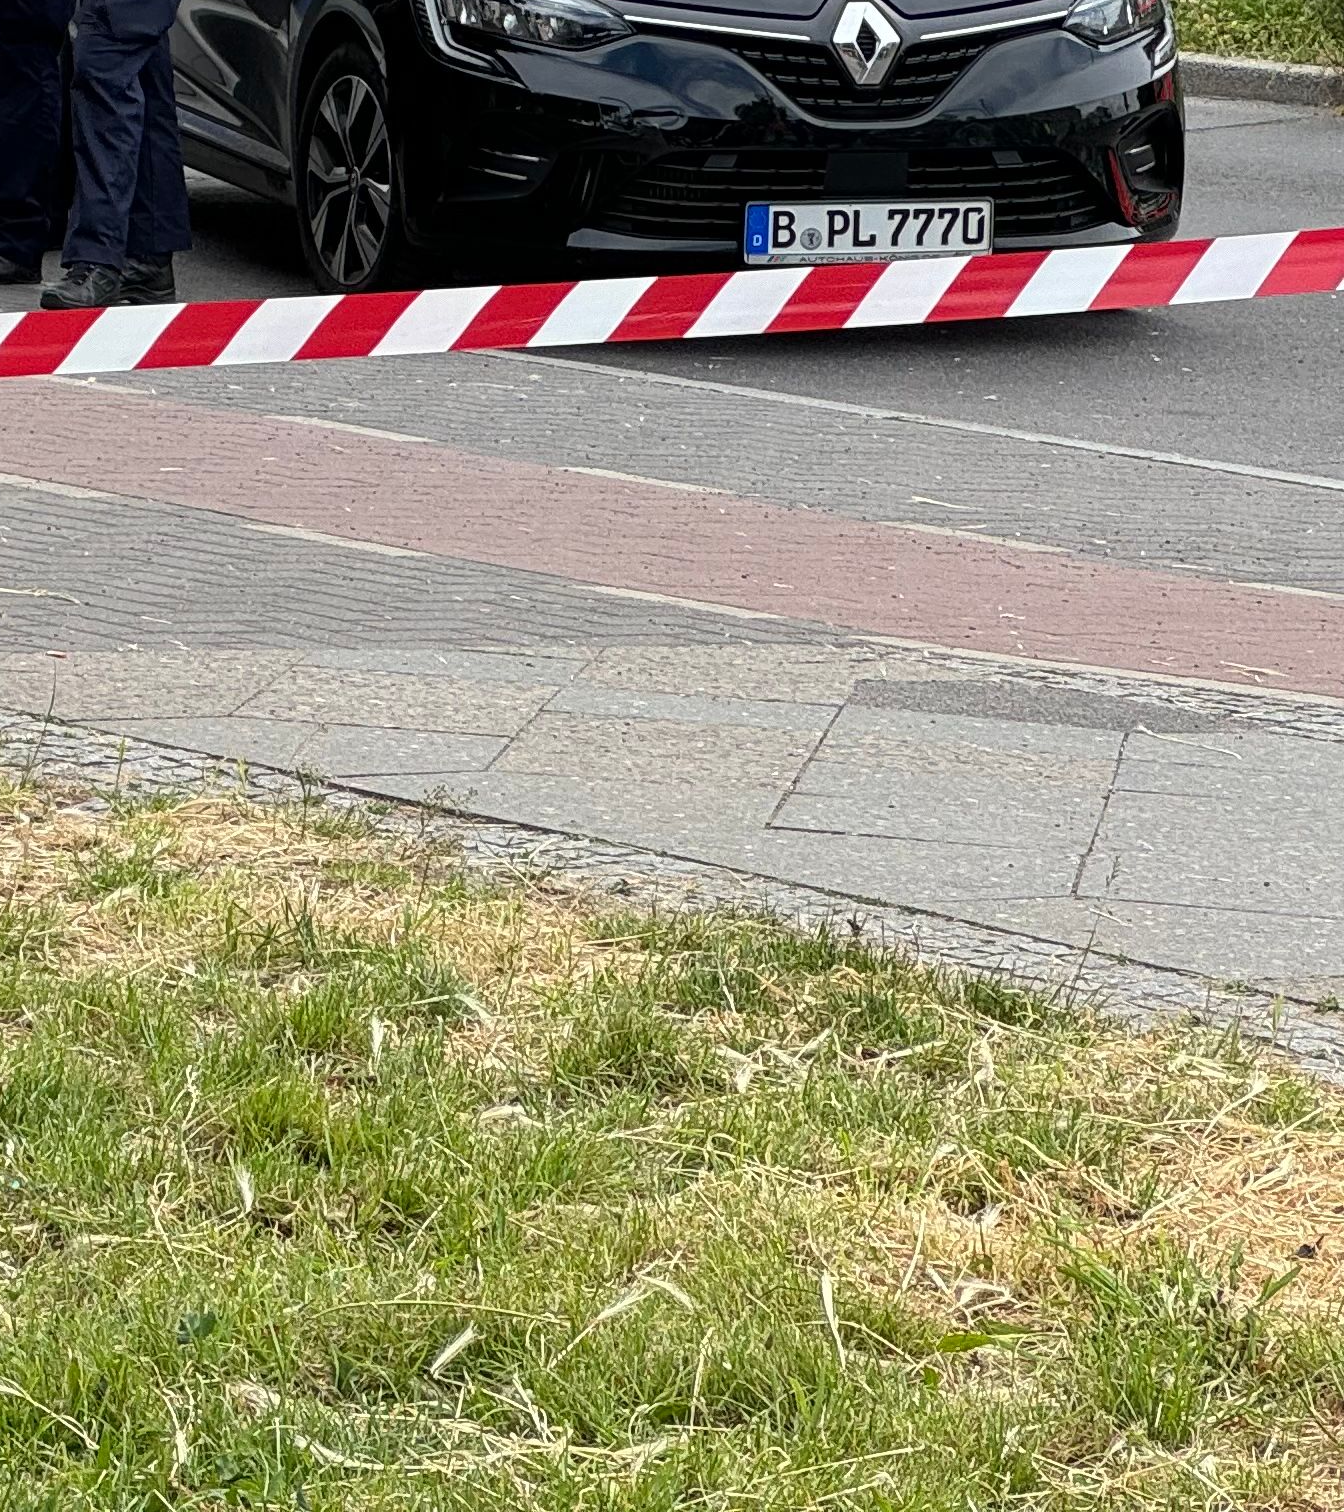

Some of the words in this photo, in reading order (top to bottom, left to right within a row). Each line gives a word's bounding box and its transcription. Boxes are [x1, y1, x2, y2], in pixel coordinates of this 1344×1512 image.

[772, 210, 797, 249] B
[827, 209, 877, 248] PL
[887, 207, 985, 247] 7770
